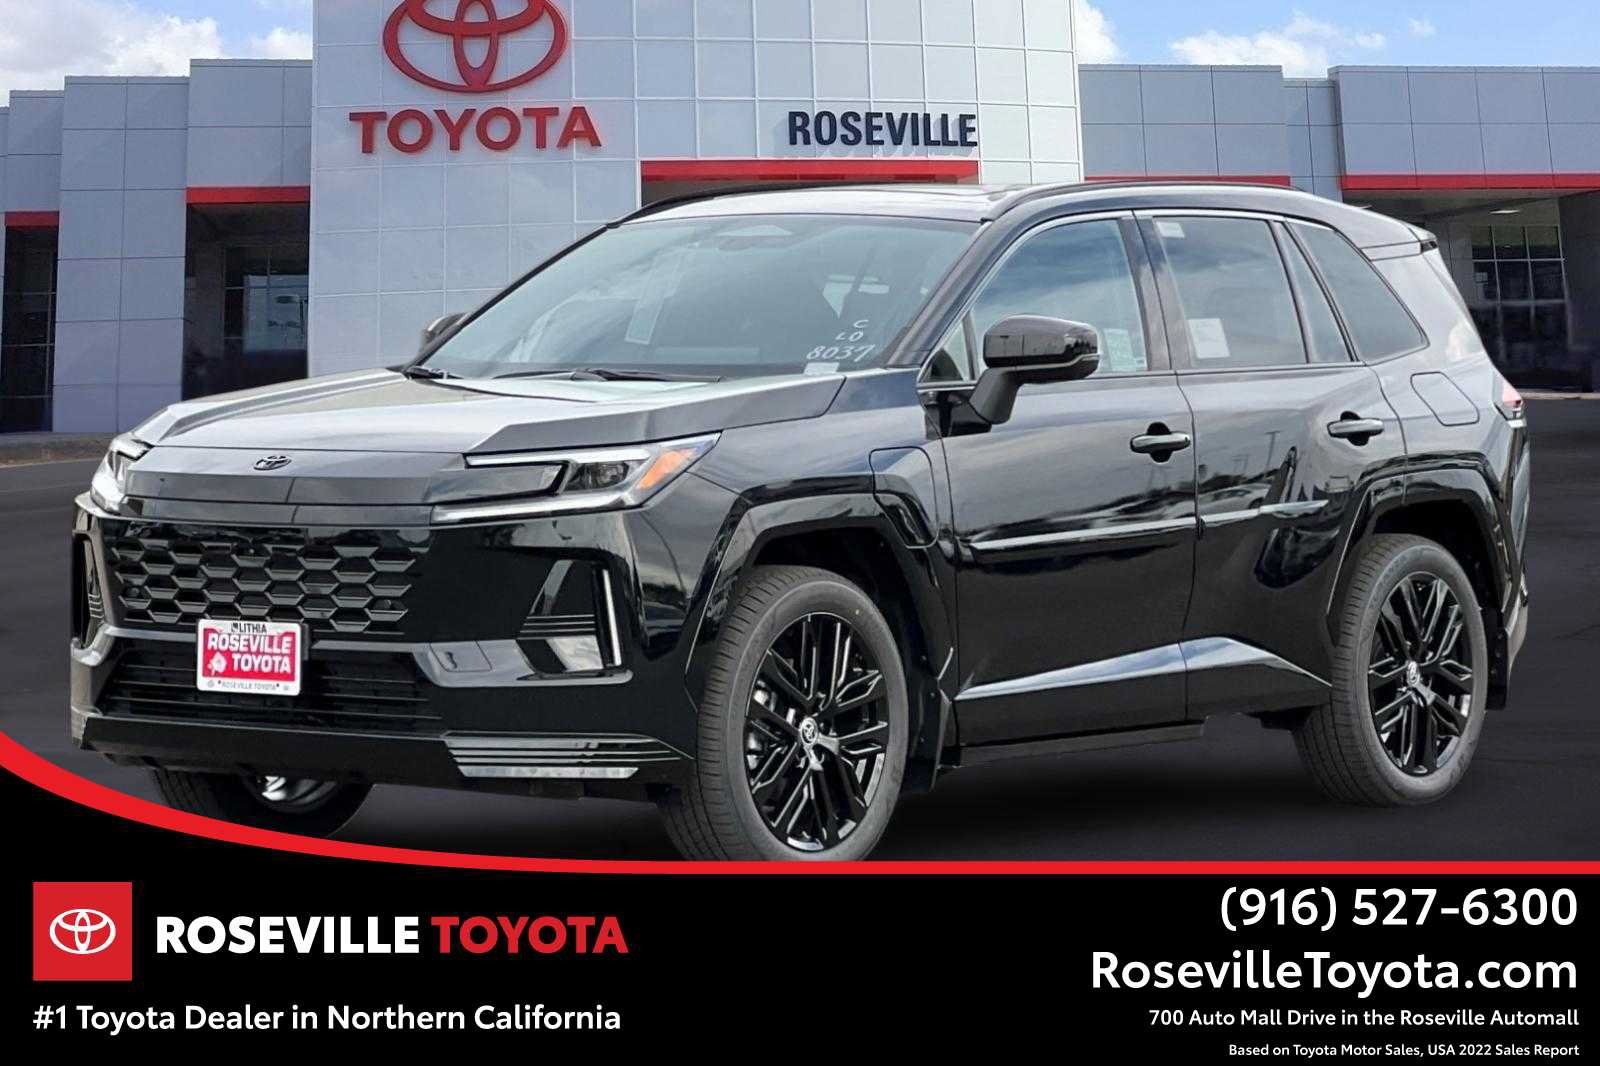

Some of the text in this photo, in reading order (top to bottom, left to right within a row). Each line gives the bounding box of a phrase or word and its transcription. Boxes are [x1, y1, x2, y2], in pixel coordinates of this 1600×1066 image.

[349, 106, 602, 154] TOYOTA
[788, 110, 978, 147] ROSEVILLE
[806, 343, 876, 363] 8037
[240, 622, 268, 634] LITHIA
[207, 632, 293, 655] ROSEVILLE
[231, 653, 292, 674] TOYOTA
